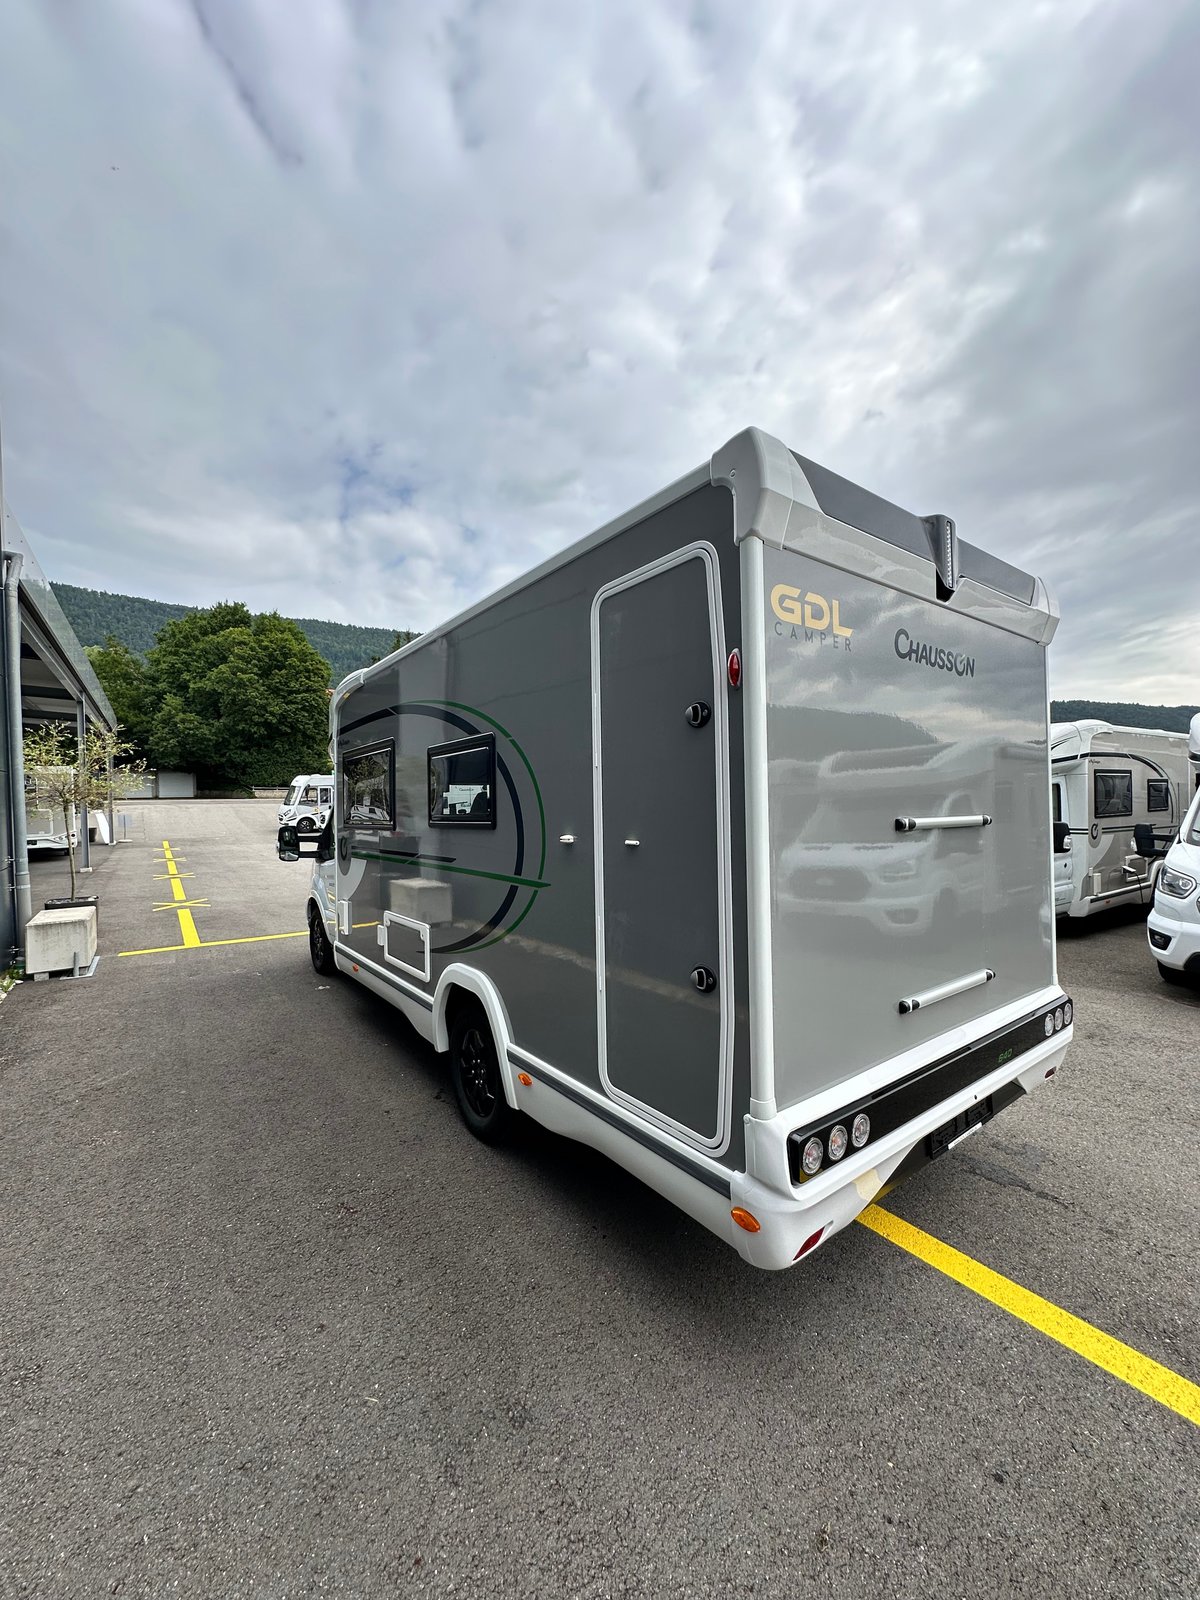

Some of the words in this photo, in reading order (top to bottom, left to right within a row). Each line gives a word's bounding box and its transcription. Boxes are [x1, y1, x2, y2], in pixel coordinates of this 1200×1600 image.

[770, 583, 854, 637] GDL
[774, 621, 852, 652] CAMPER
[894, 628, 976, 678] CHAUSSON
[998, 1048, 1013, 1063] 640
